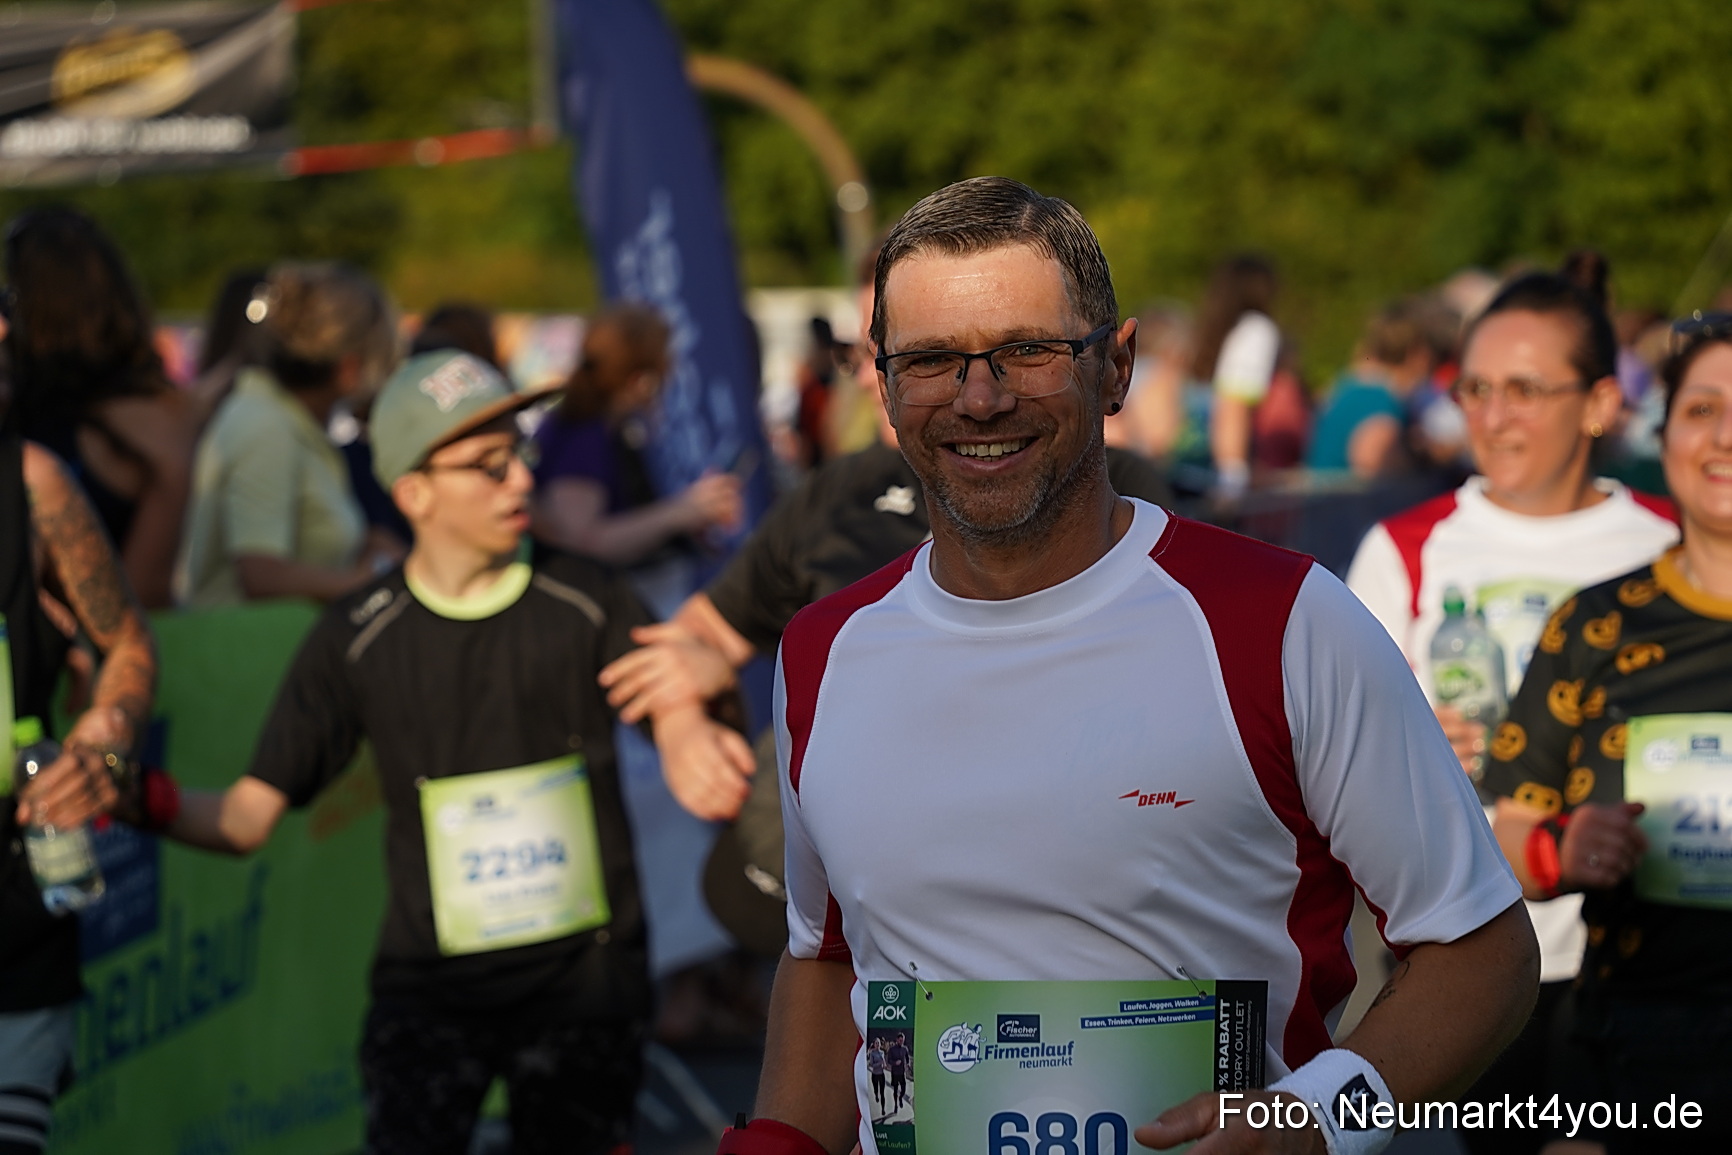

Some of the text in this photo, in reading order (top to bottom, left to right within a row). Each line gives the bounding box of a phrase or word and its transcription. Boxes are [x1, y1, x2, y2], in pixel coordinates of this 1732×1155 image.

[1137, 791, 1177, 807] DEHN
[872, 1005, 907, 1020] AOK
[1123, 999, 1199, 1011] Laufen, Joggen, Walken
[1084, 1013, 1196, 1028] Essen, Trinken, Feiern, Netzwerken
[1234, 1000, 1245, 1052] OUTLET
[1218, 999, 1230, 1069] RABATT
[984, 1040, 1075, 1060] Firmenlauf
[1019, 1056, 1073, 1069] neumarkt
[1218, 1072, 1229, 1086] %
[988, 1111, 1129, 1155] 680
